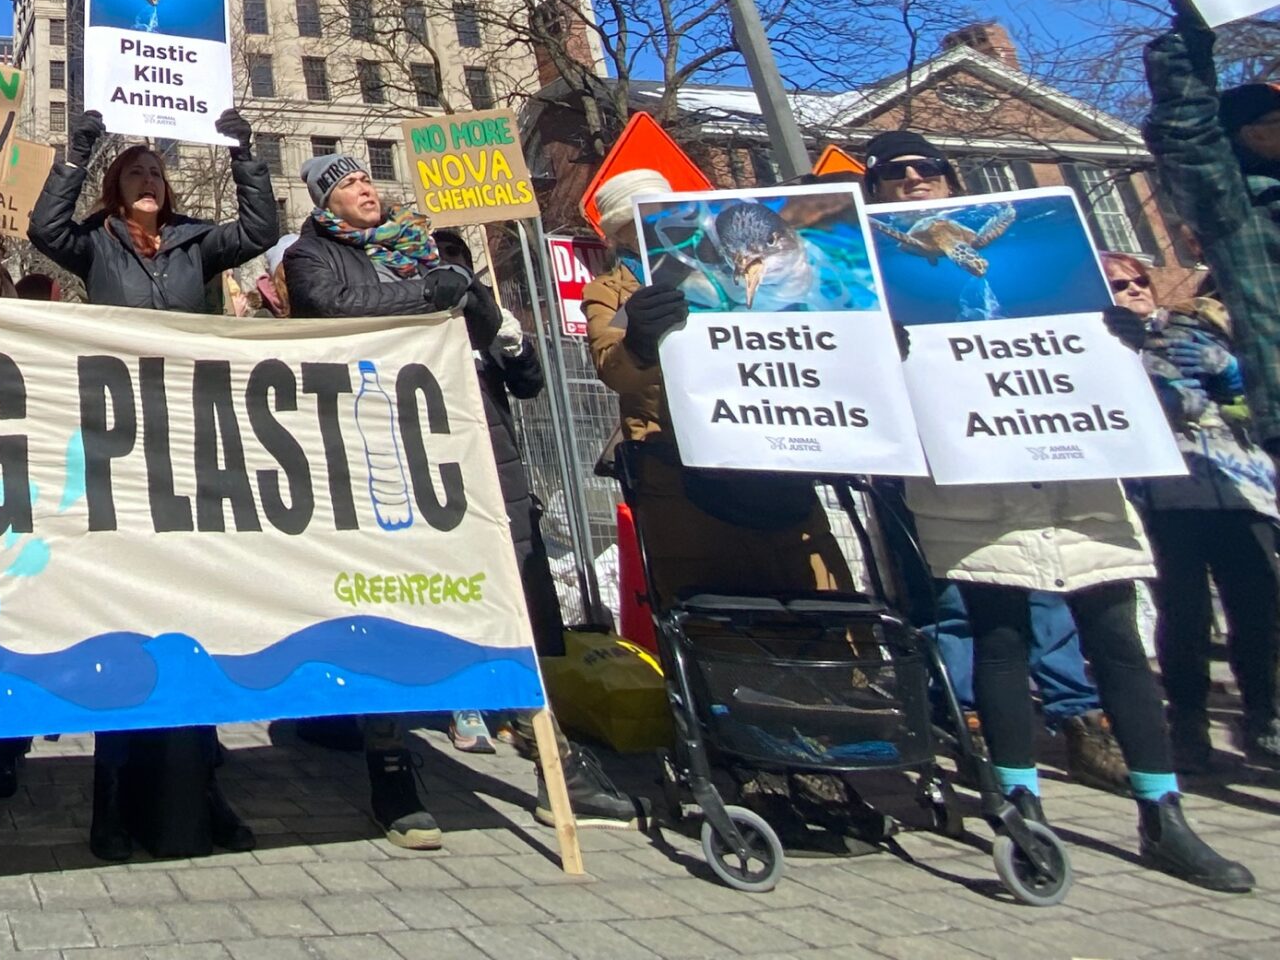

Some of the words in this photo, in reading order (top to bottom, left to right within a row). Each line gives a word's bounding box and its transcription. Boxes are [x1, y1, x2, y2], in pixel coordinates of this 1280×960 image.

[120, 38, 198, 64] Plastic
[134, 65, 184, 86] Kills
[110, 86, 208, 114] Animals
[411, 124, 446, 154] NO
[450, 116, 515, 148] MORE
[417, 149, 513, 190] NOVA
[424, 180, 534, 214] CHEMICALS
[707, 325, 838, 352] Plastic
[948, 330, 1086, 362] Plastic
[738, 362, 821, 388] Kills
[986, 368, 1075, 397] Kills
[711, 398, 869, 428] Animals
[966, 403, 1131, 438] Animals
[333, 571, 487, 607] GREENPEACE
